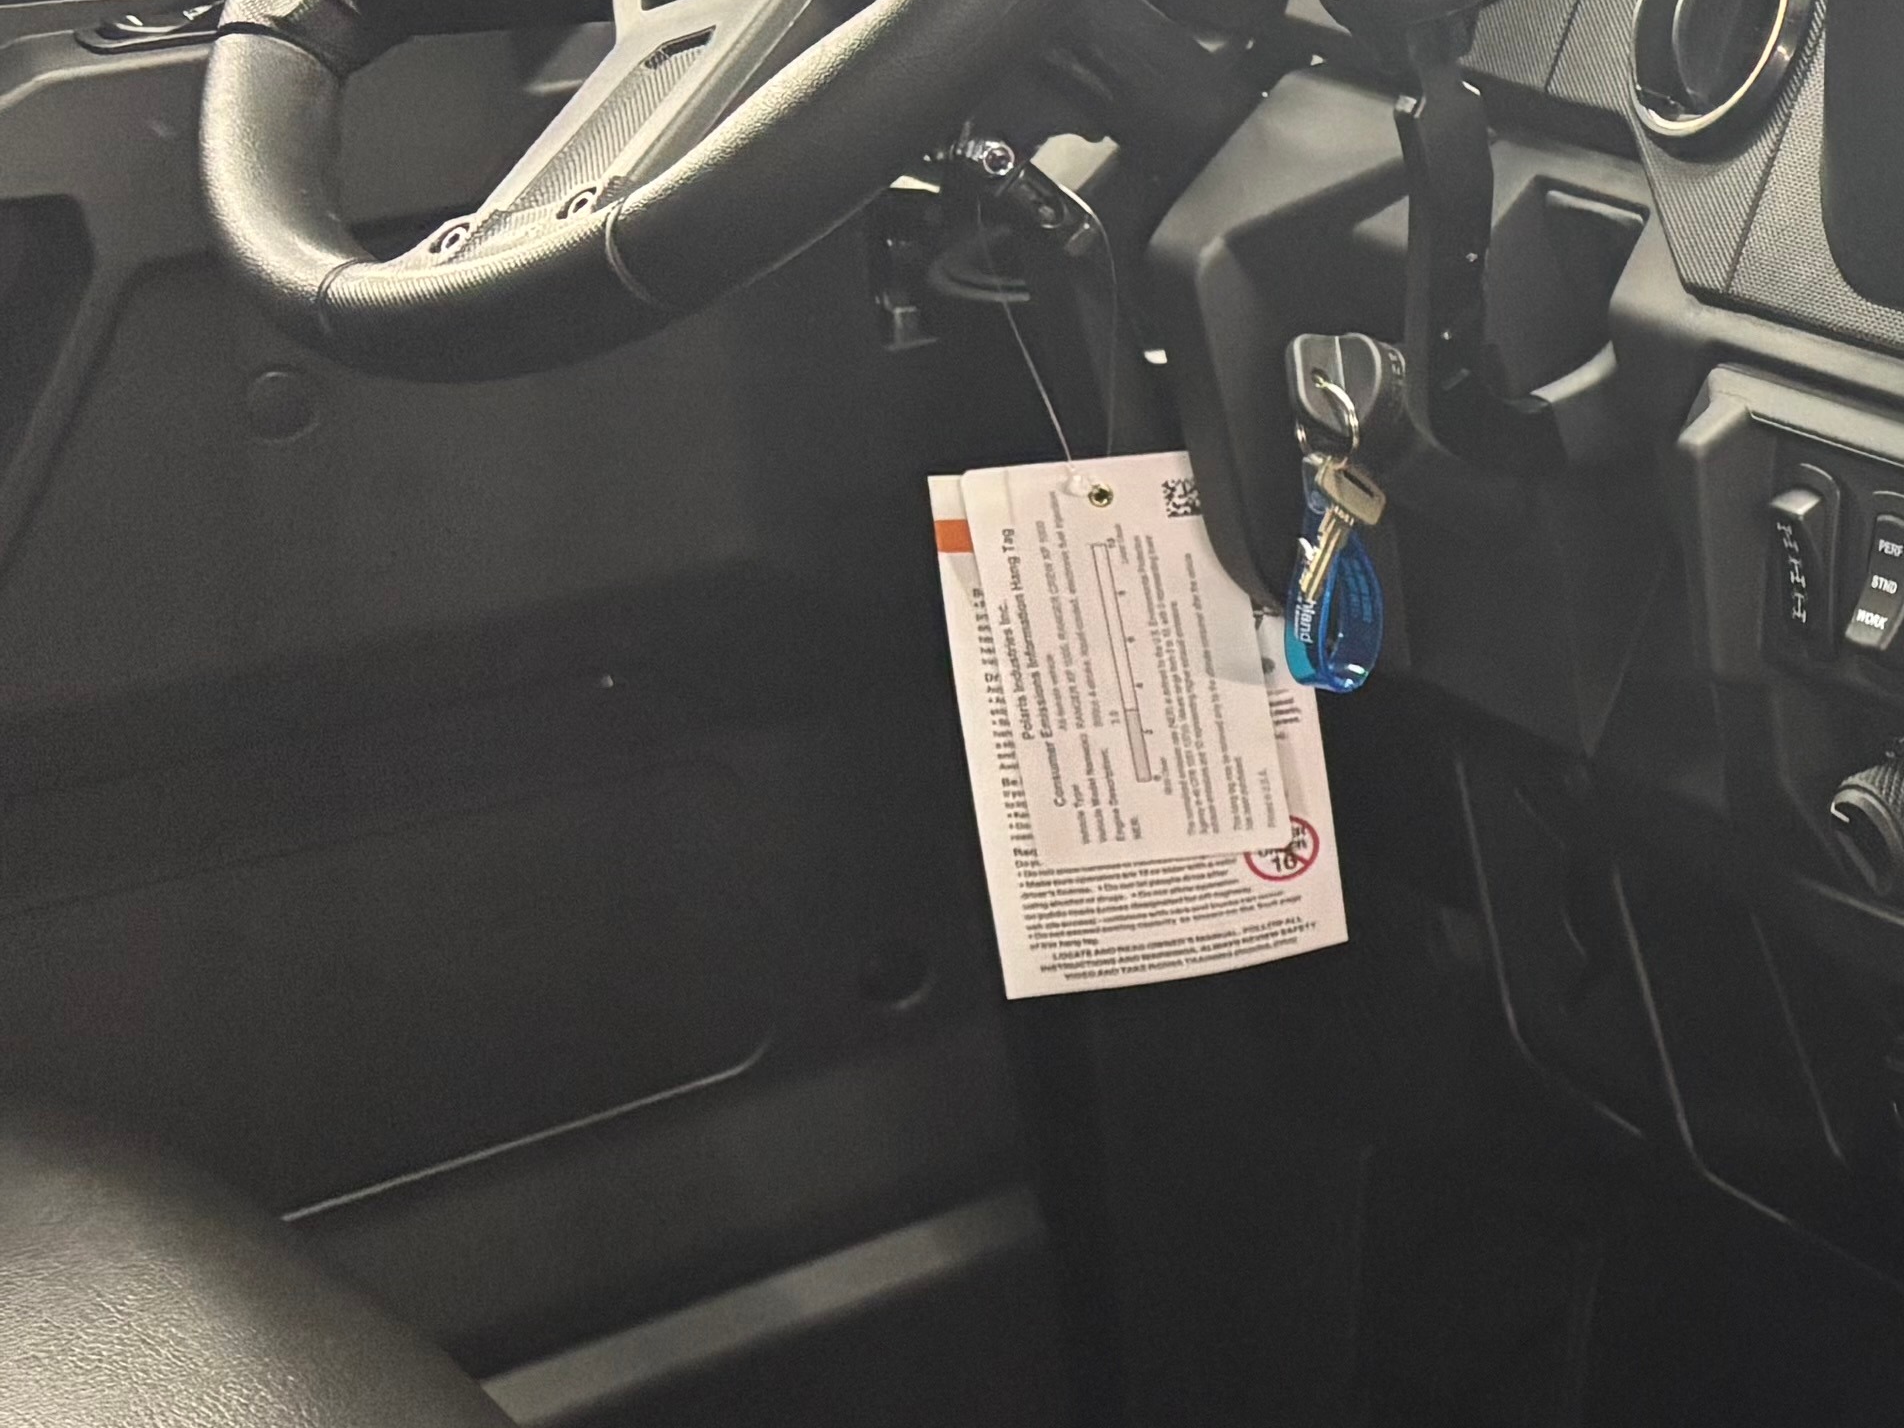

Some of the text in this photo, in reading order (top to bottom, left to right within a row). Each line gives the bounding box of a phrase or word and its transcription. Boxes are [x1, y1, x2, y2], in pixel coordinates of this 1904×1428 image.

[1000, 527, 1016, 552] Tag
[1878, 539, 1904, 557] PERF
[1005, 555, 1024, 590] Hang
[1871, 575, 1897, 594] STND
[1013, 594, 1037, 668] Information
[1856, 609, 1888, 629] WORK
[995, 601, 1034, 740] Polaris Industries Inc.
[1029, 671, 1051, 738] Emissions
[1044, 739, 1065, 807] Consumer
